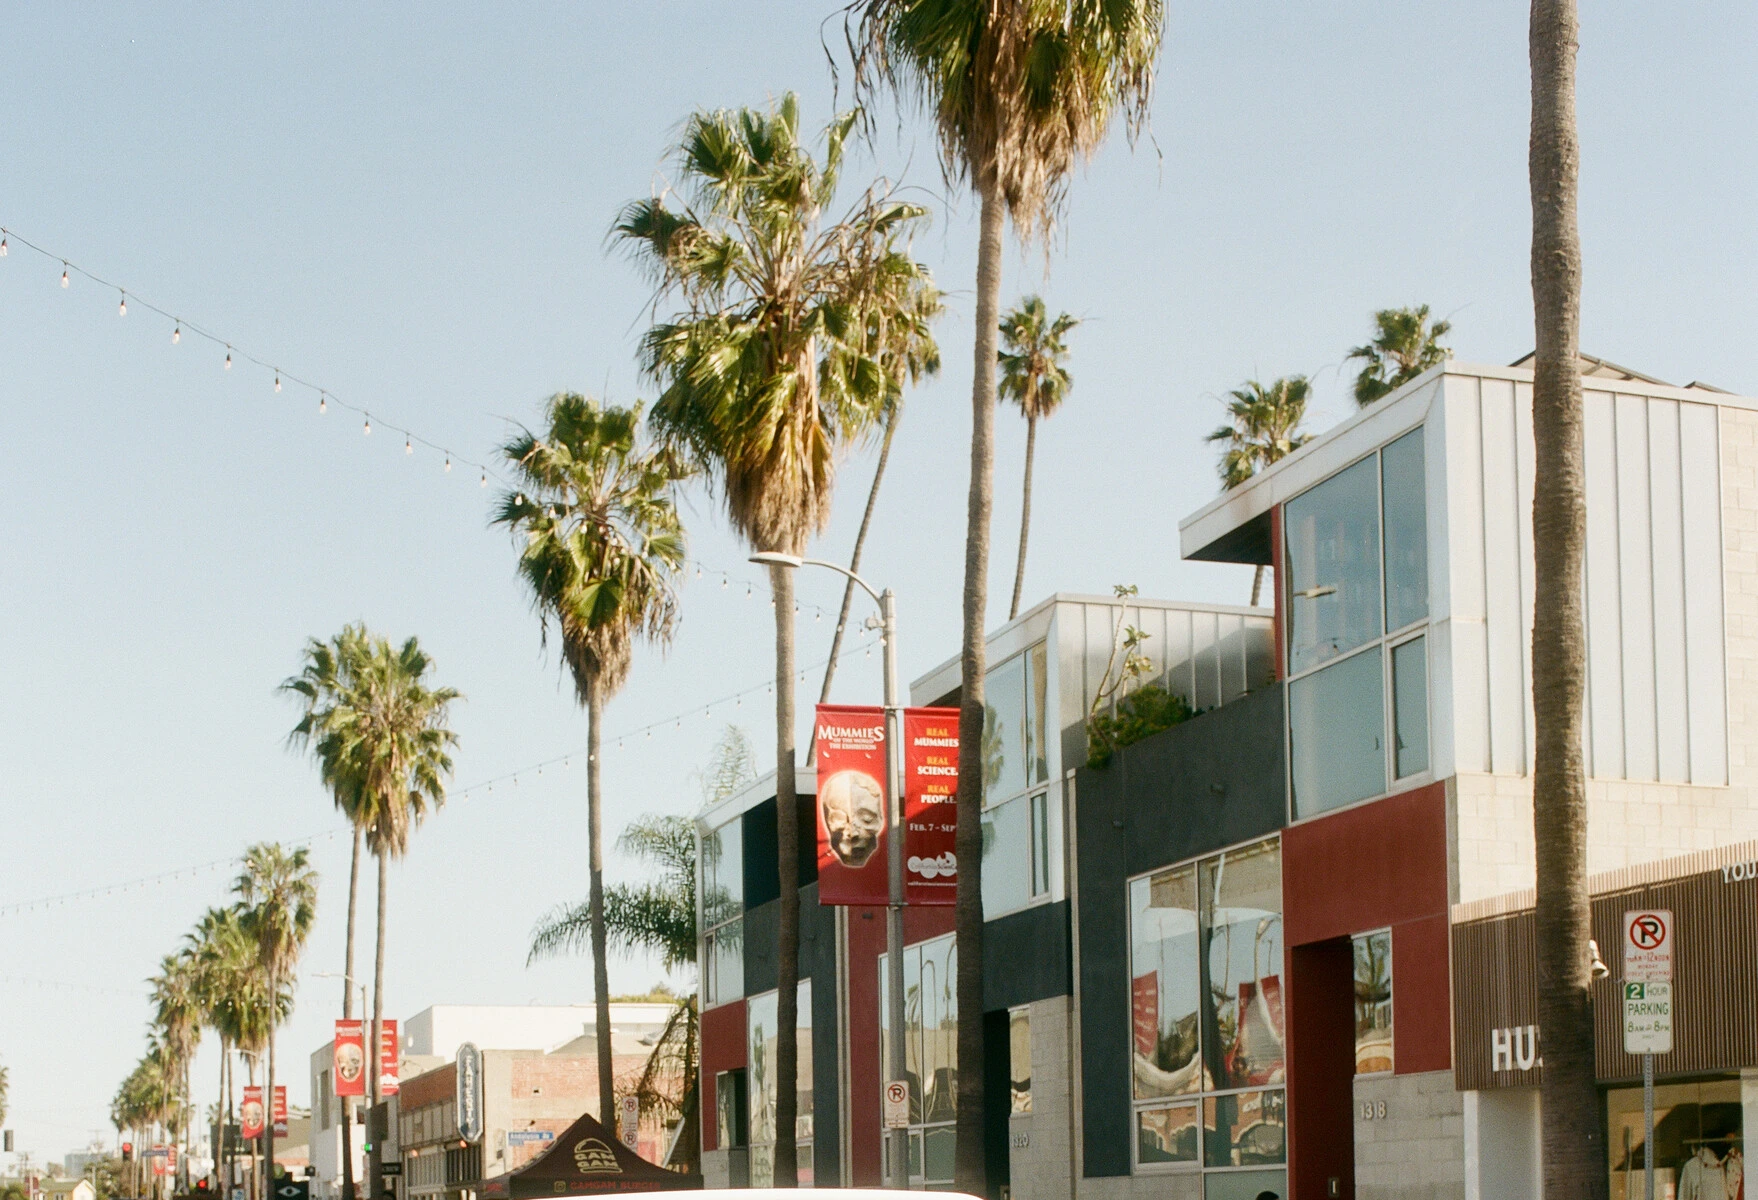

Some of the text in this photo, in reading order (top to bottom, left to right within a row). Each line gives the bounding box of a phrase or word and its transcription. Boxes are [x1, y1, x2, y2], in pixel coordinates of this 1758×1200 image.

[818, 725, 884, 742] MUMMIES
[926, 728, 949, 736] REAL
[927, 756, 948, 765] REAL
[927, 784, 950, 794] REAL
[1630, 984, 1667, 998] 2 HOUR
[1628, 1002, 1669, 1015] PARKING
[1492, 1025, 1543, 1071] HU
[574, 1152, 616, 1160] GAM
[577, 1160, 620, 1168] GAM
